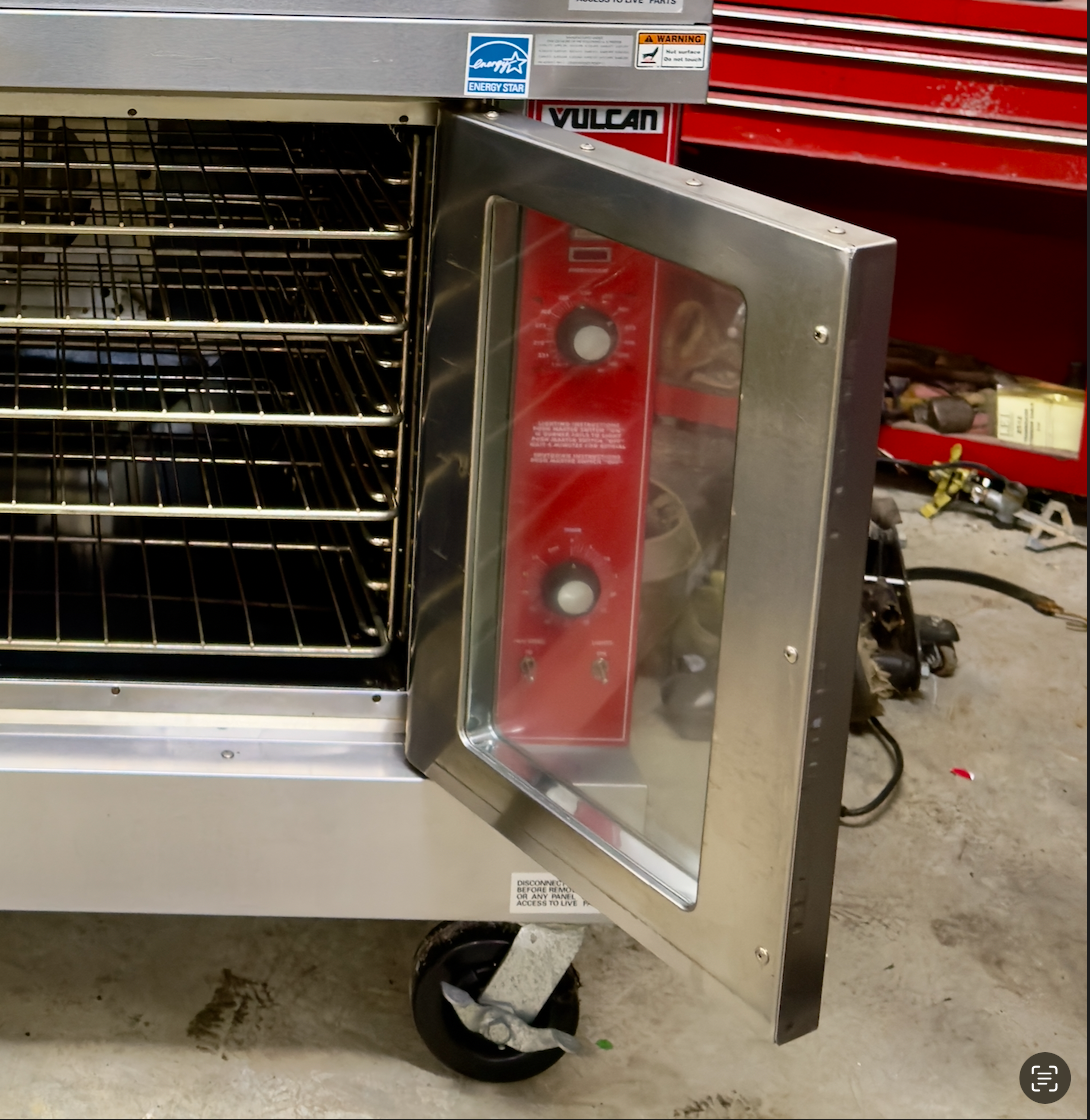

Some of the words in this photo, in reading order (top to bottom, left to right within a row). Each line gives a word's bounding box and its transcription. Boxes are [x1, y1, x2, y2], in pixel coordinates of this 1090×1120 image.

[657, 35, 701, 43] WARNING
[469, 82, 502, 92] ENERGY
[503, 83, 524, 92] STAR
[549, 107, 658, 130] VULCAN
